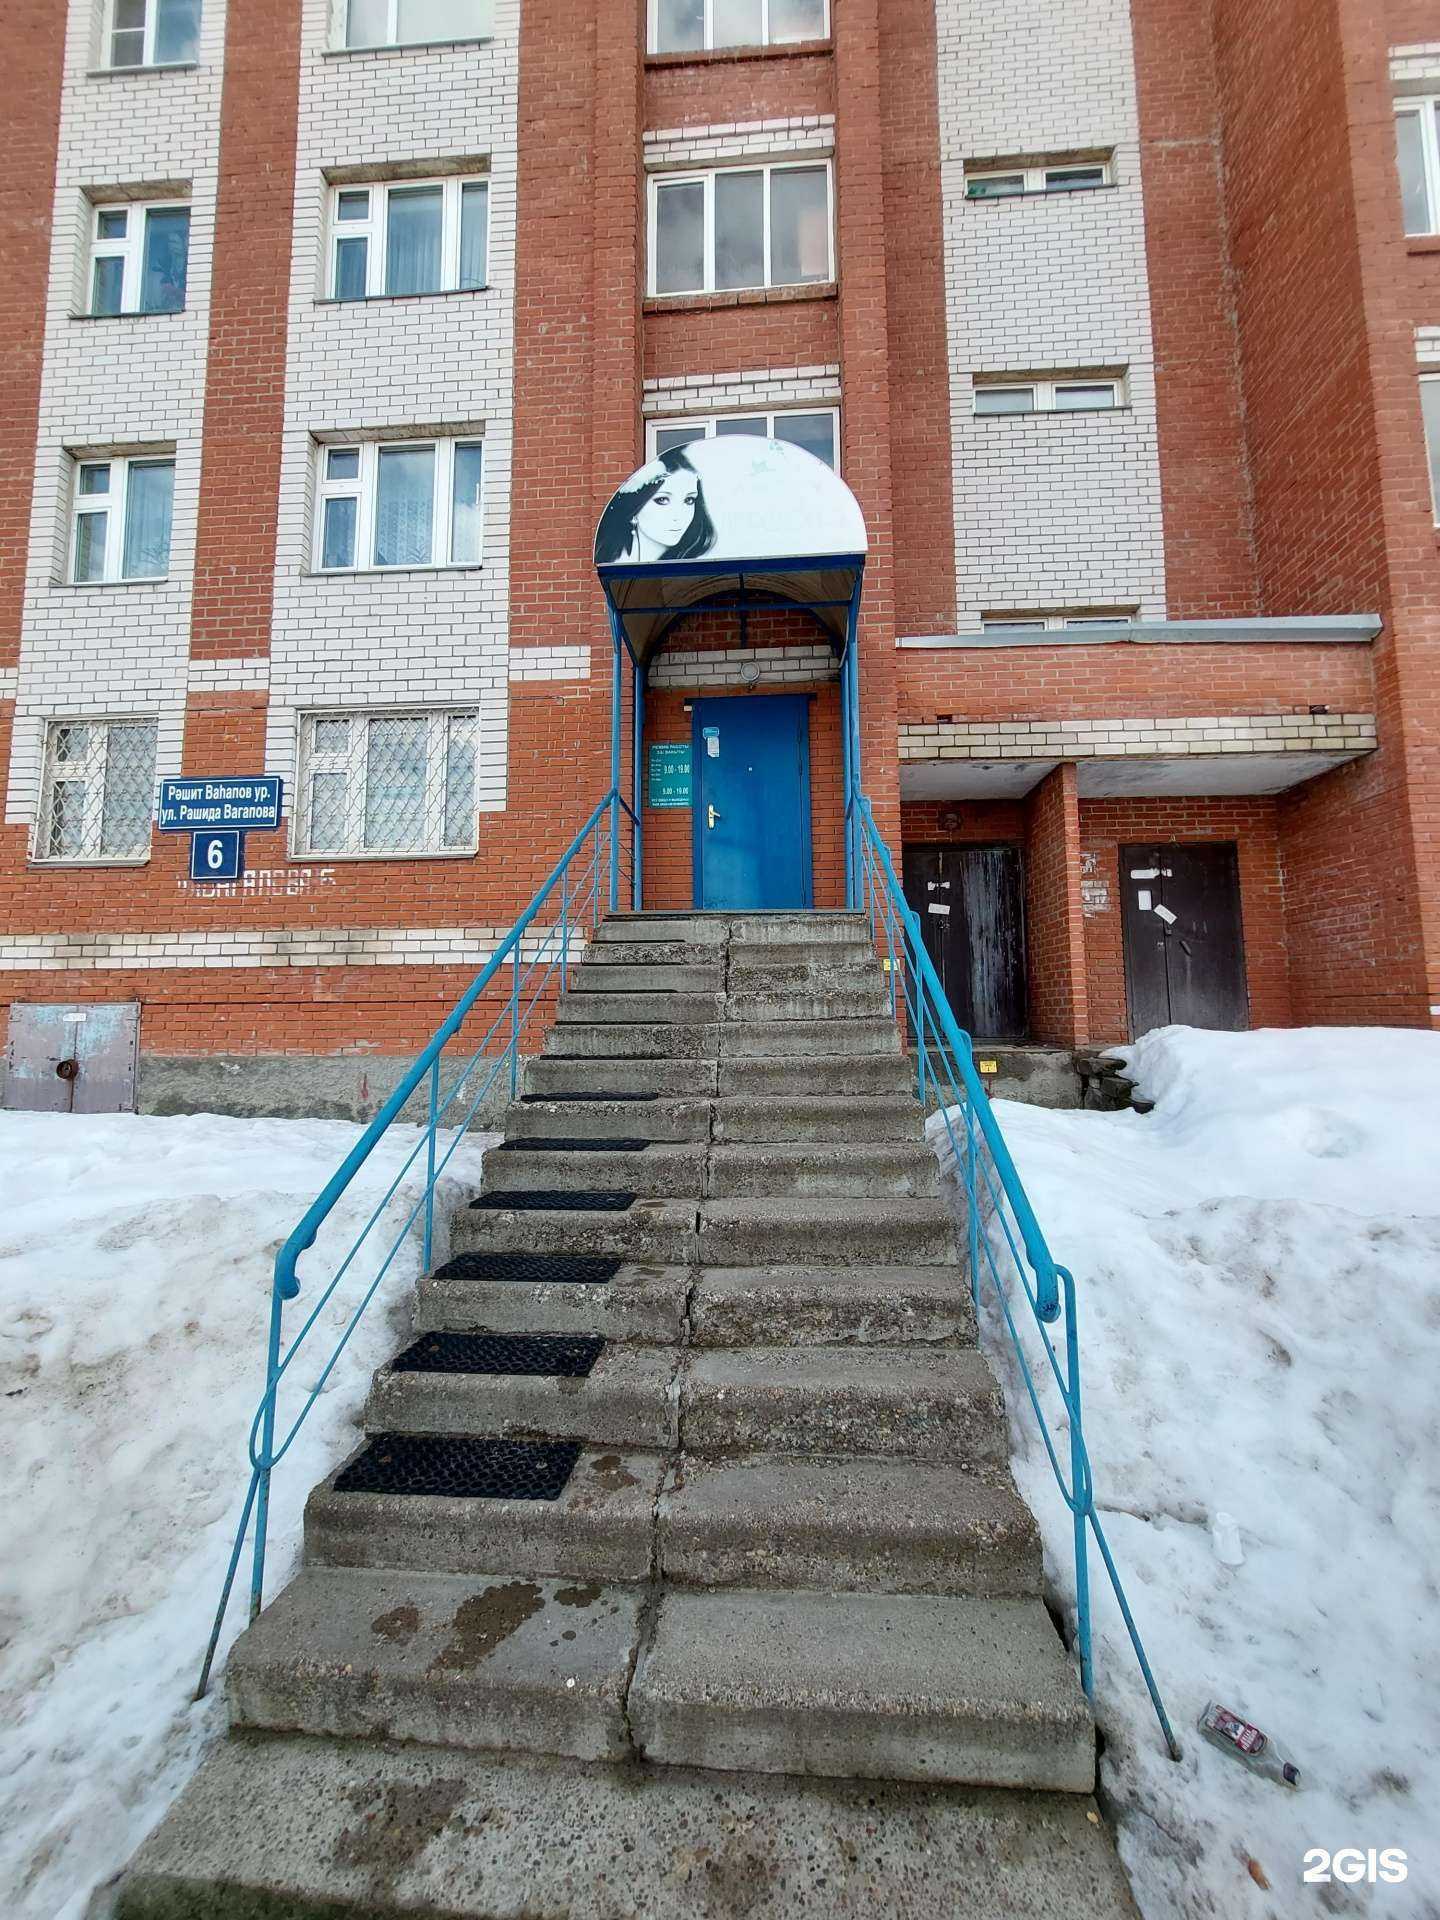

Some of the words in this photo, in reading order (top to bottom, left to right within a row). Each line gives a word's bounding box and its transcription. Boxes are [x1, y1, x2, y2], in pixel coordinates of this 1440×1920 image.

[168, 786, 203, 801] Рәшит
[205, 784, 252, 799] Ваһапов
[254, 785, 271, 802] ур.
[161, 808, 177, 824] ул.
[180, 806, 221, 822] Рашида
[224, 803, 275, 820] Вагапова
[207, 839, 223, 869] 6
